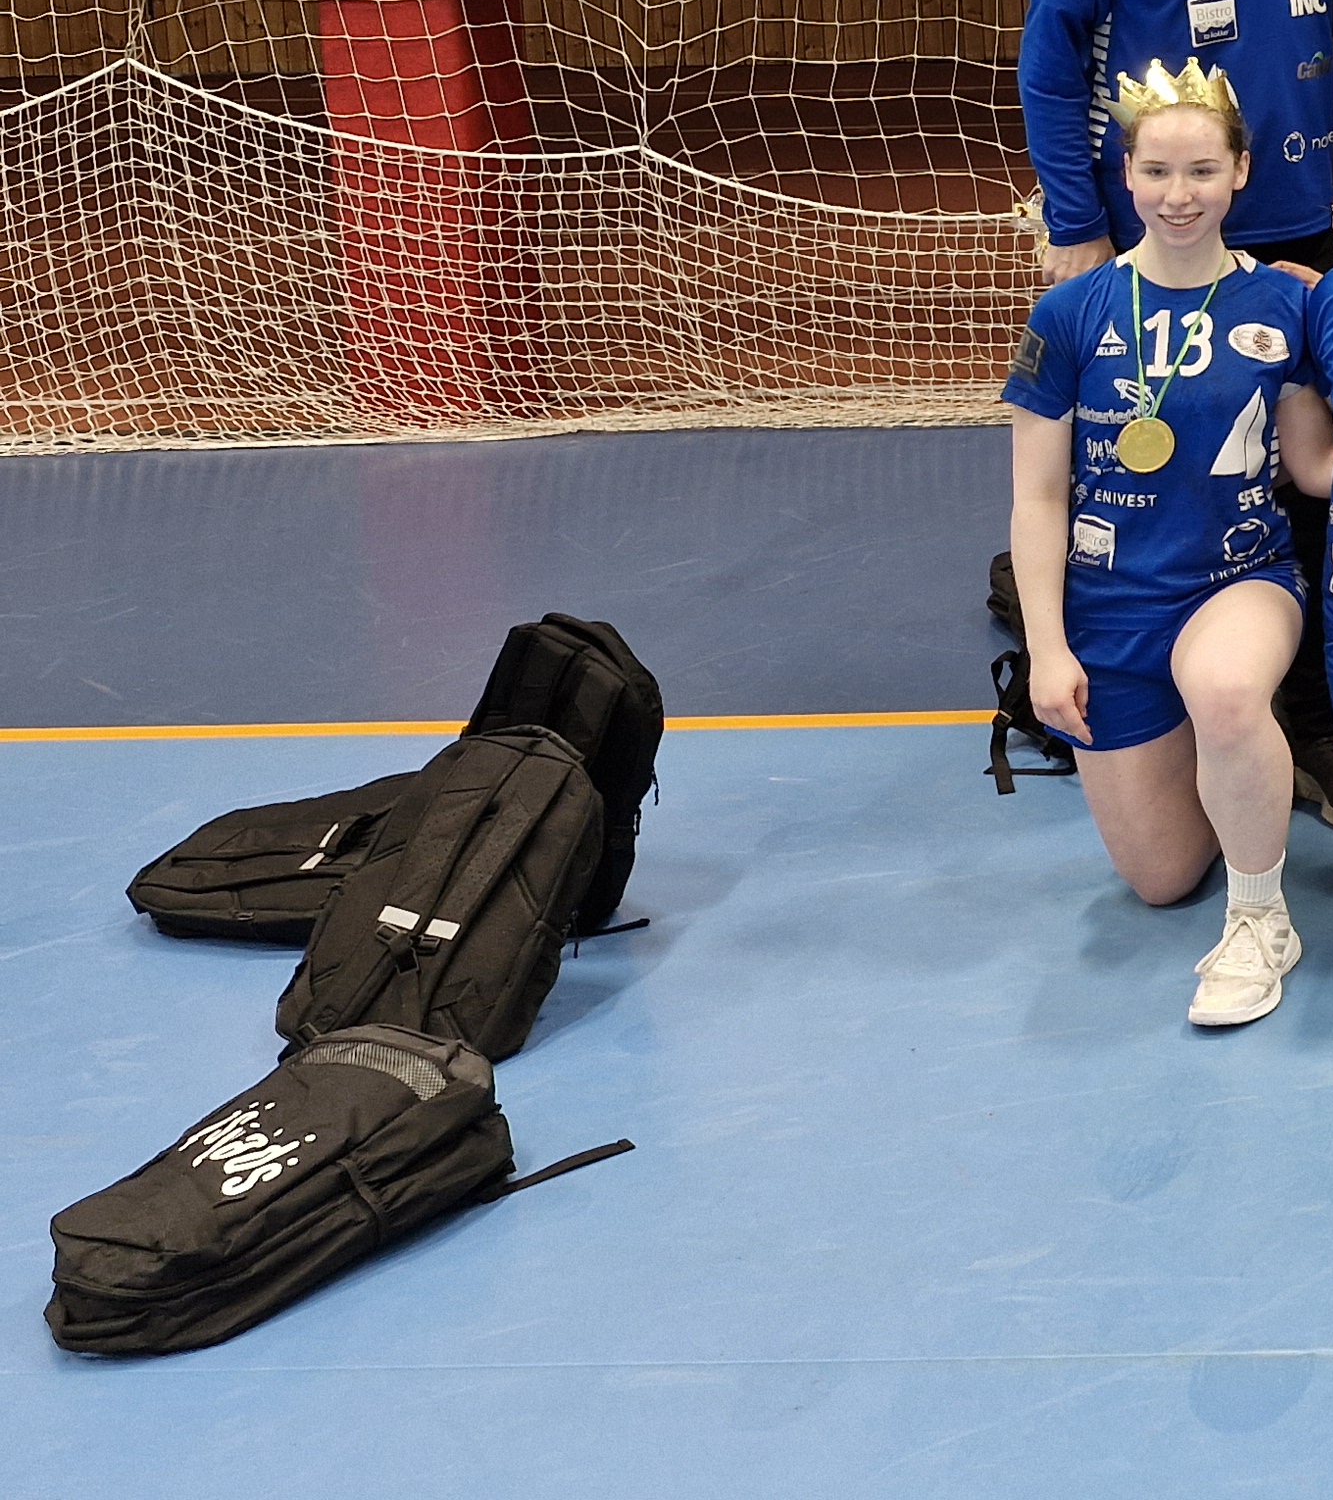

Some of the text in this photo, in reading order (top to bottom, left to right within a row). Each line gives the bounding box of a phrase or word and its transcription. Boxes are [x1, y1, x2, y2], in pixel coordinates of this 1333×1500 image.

[1196, 6, 1231, 21] Bistro
[1095, 345, 1128, 356] SELECT
[1142, 309, 1214, 377] 13
[1094, 488, 1157, 508] ENIVEST
[1237, 485, 1265, 512] SFE
